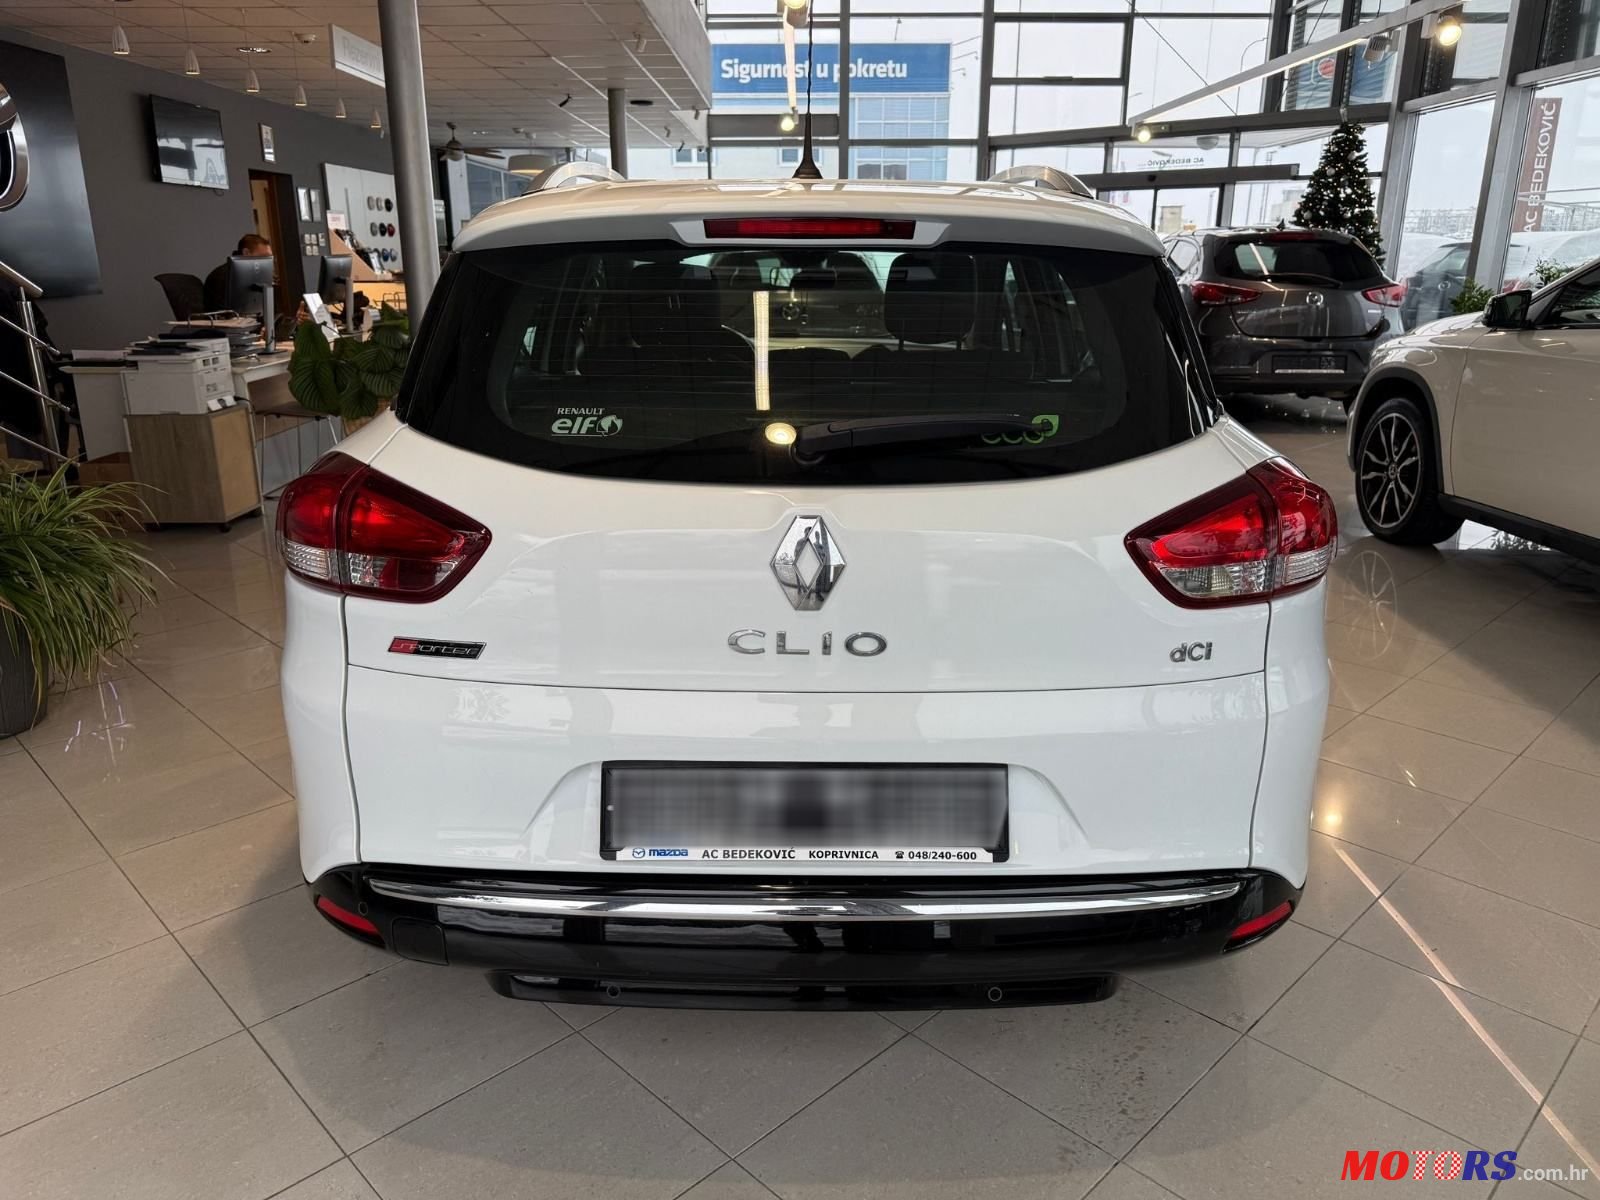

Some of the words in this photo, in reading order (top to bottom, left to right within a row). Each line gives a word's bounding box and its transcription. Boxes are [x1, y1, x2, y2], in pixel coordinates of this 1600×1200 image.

[816, 63, 829, 78] u
[1527, 102, 1556, 206] BEDEKOVIĆ
[1524, 210, 1538, 232] AC
[557, 407, 605, 415] RENAULT
[551, 416, 598, 434] elf
[727, 629, 888, 657] CLIO
[1169, 641, 1213, 663] dCi
[648, 848, 689, 858] mazda
[702, 849, 719, 859] AC
[722, 847, 796, 860] BEDEKOVIĆ
[808, 850, 879, 860] KOPRIVNICA
[908, 850, 977, 861] 048/240-600
